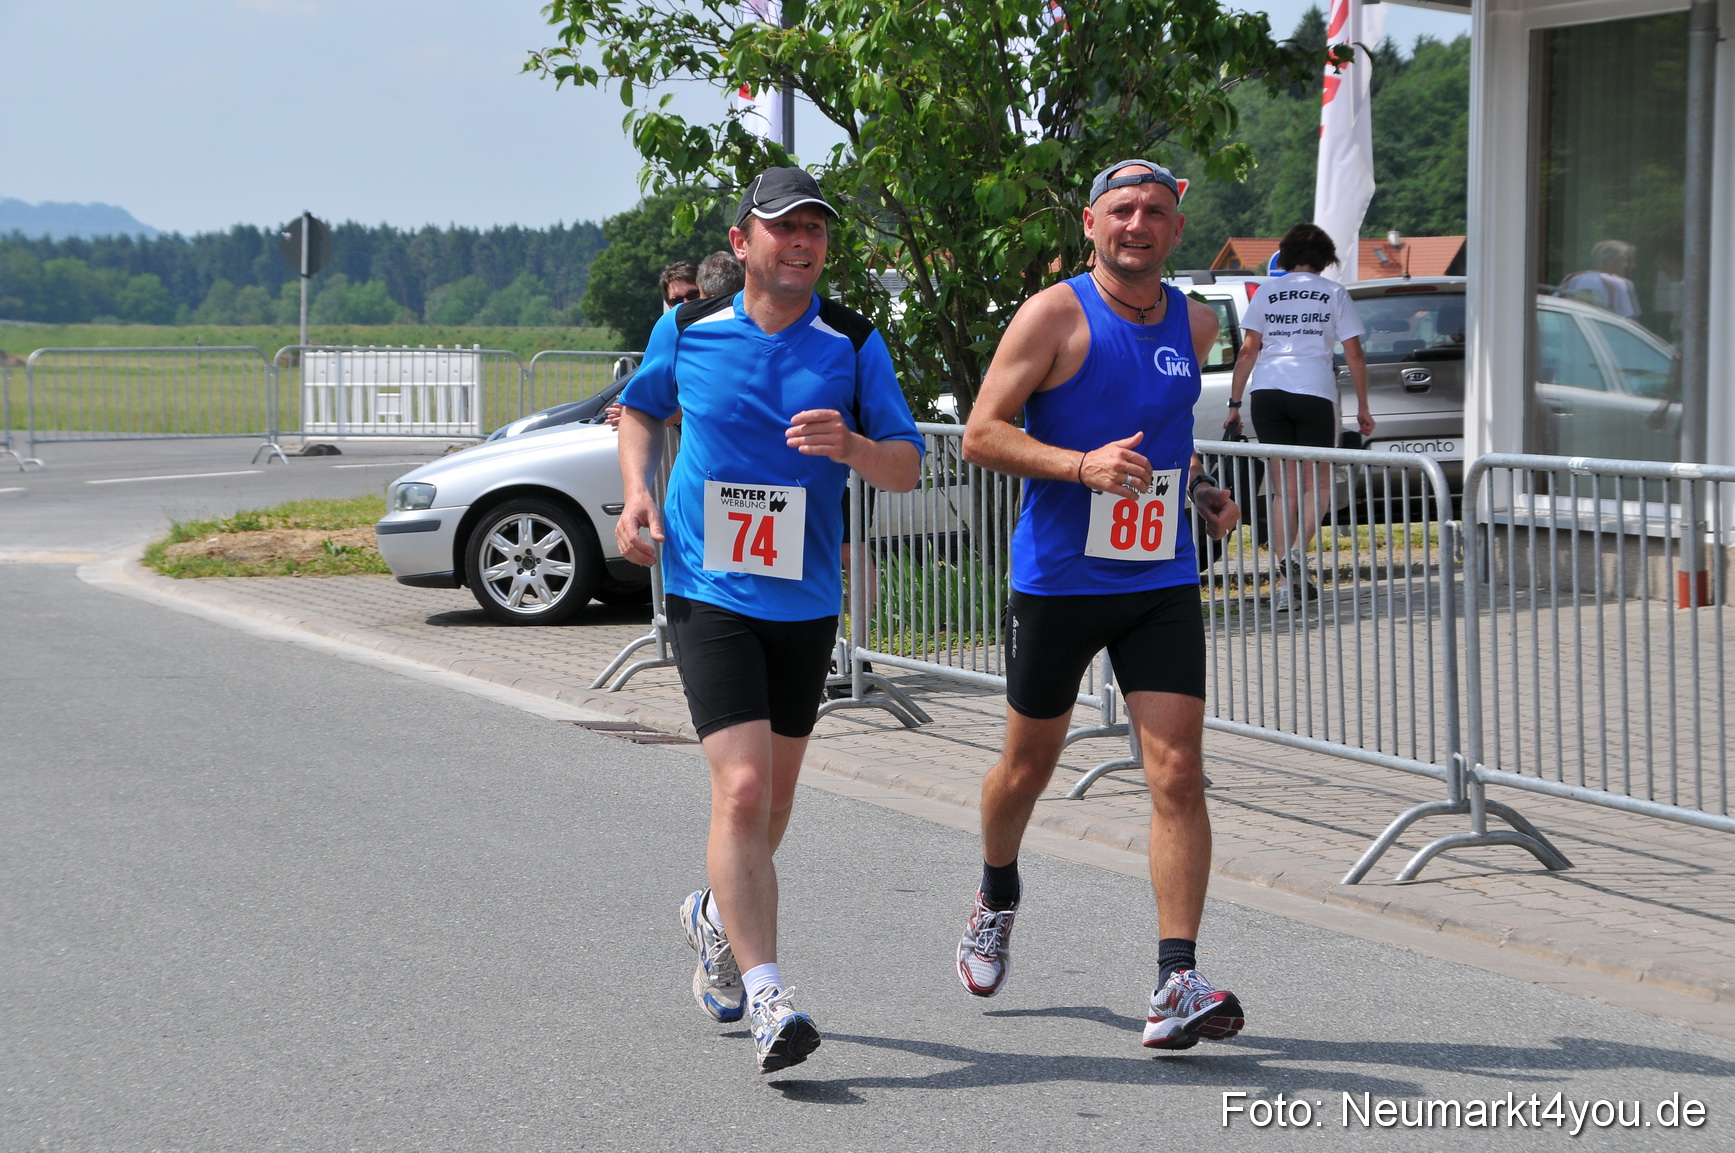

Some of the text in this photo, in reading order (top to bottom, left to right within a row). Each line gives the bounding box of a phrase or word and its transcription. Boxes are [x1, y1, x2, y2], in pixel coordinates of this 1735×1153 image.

[1268, 290, 1330, 304] BERGER
[1265, 313, 1331, 324] POWER GIRLS
[1269, 329, 1291, 337] walking
[1303, 328, 1323, 336] talking
[720, 487, 766, 501] MEYER
[720, 498, 766, 510] WERBUNG
[1110, 498, 1164, 552] 86
[728, 511, 777, 566] 74
